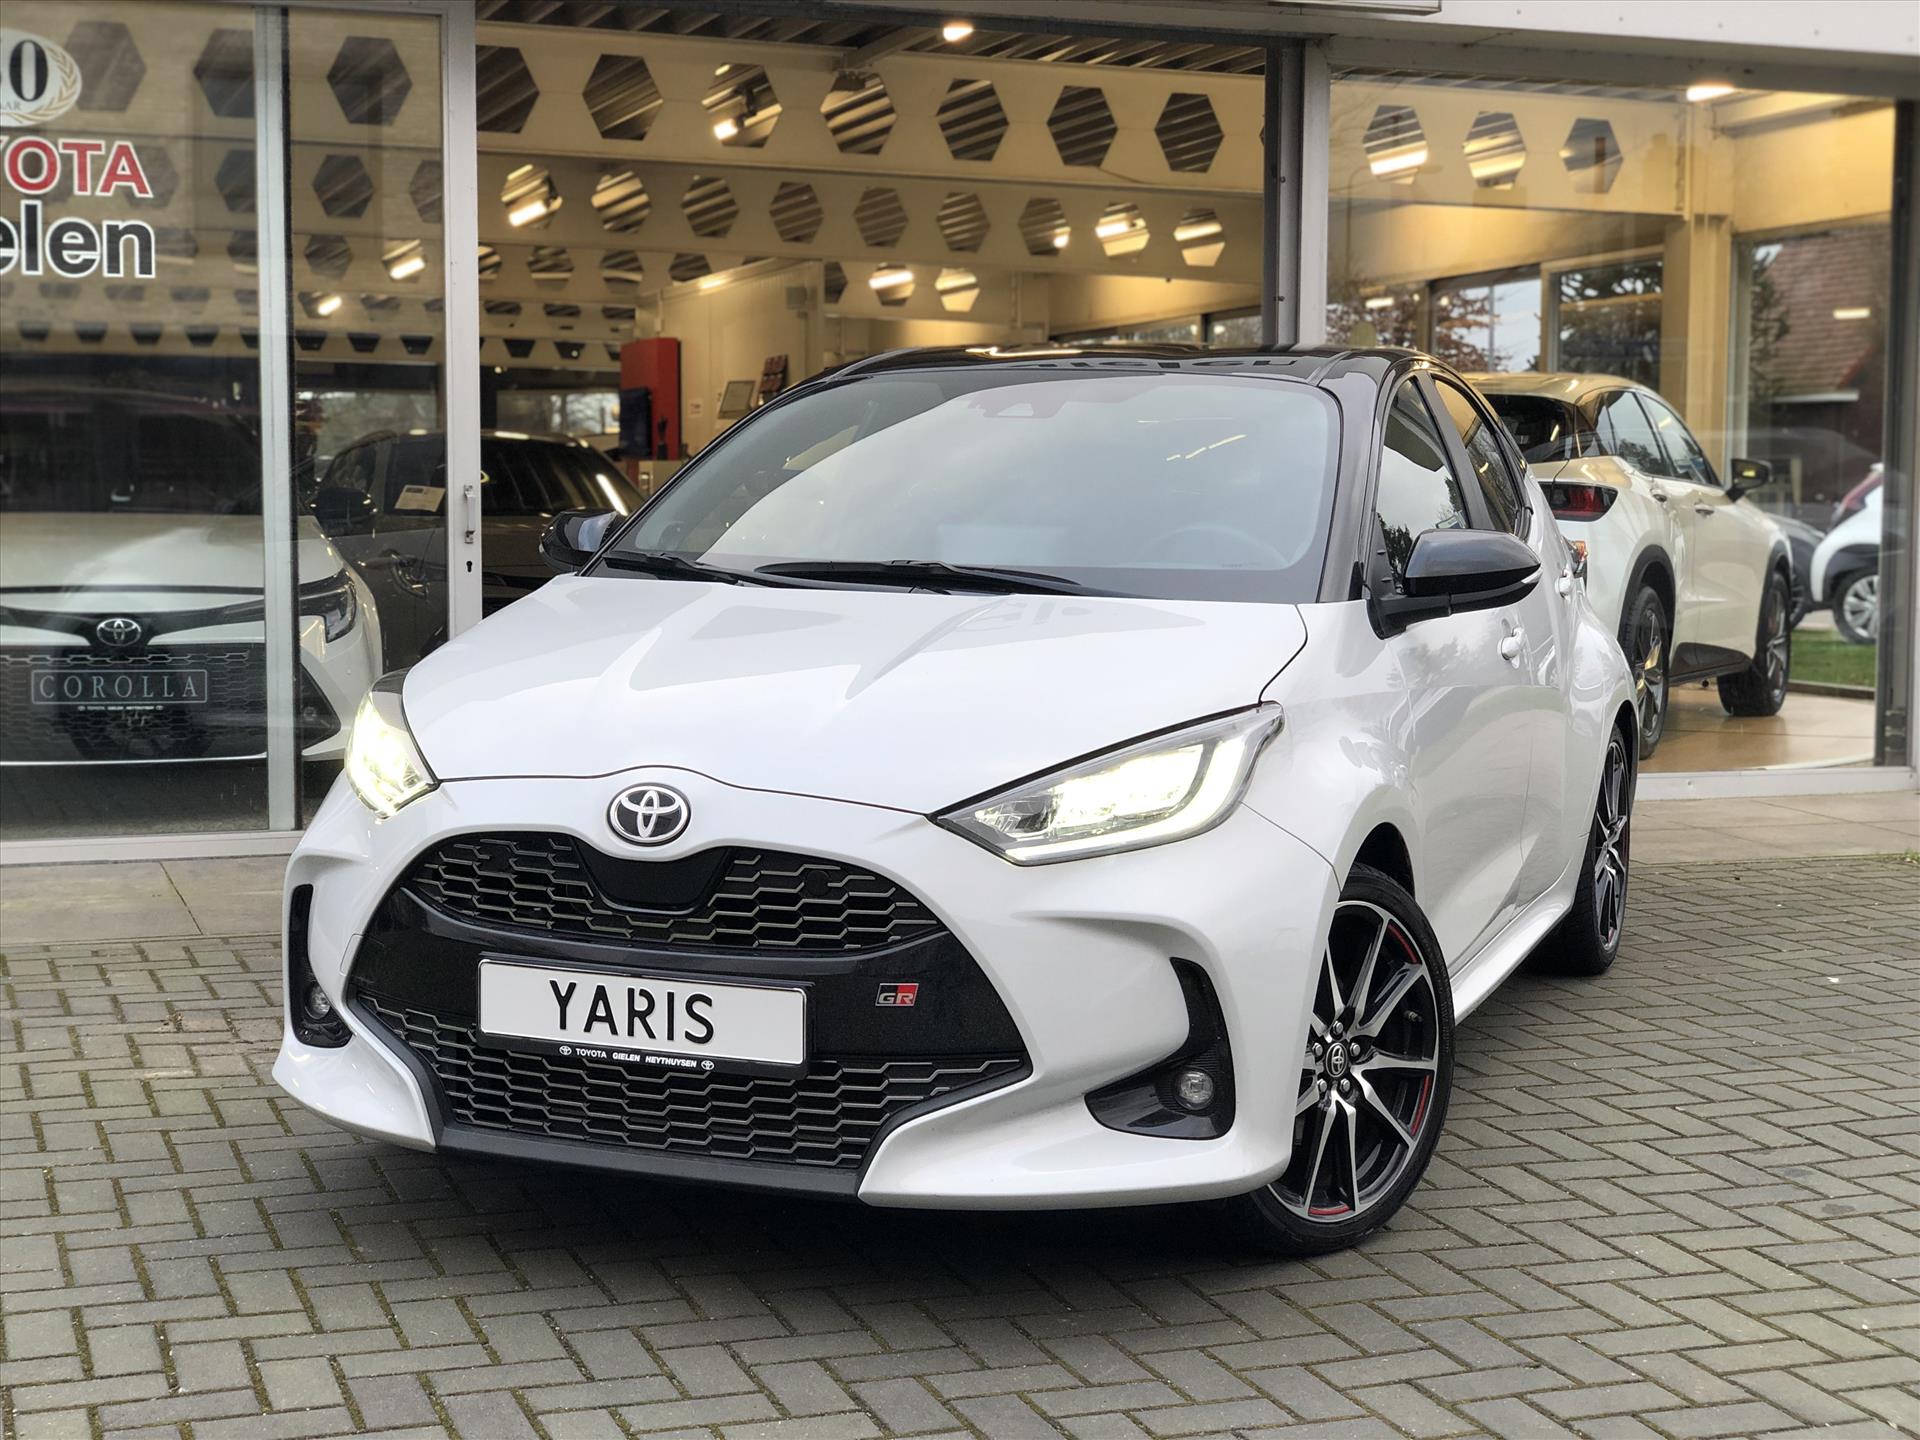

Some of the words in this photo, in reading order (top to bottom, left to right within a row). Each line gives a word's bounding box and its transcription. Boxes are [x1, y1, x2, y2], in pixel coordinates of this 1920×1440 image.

[0, 39, 48, 102] 0
[0, 136, 153, 197] OTA
[40, 676, 198, 698] COROLLA
[549, 980, 715, 1044] YARIS
[879, 992, 914, 1004] GR
[576, 1048, 607, 1058] TOYOTA
[612, 1053, 640, 1062] GIELEN
[645, 1056, 697, 1068] HEYTHUYSEN
